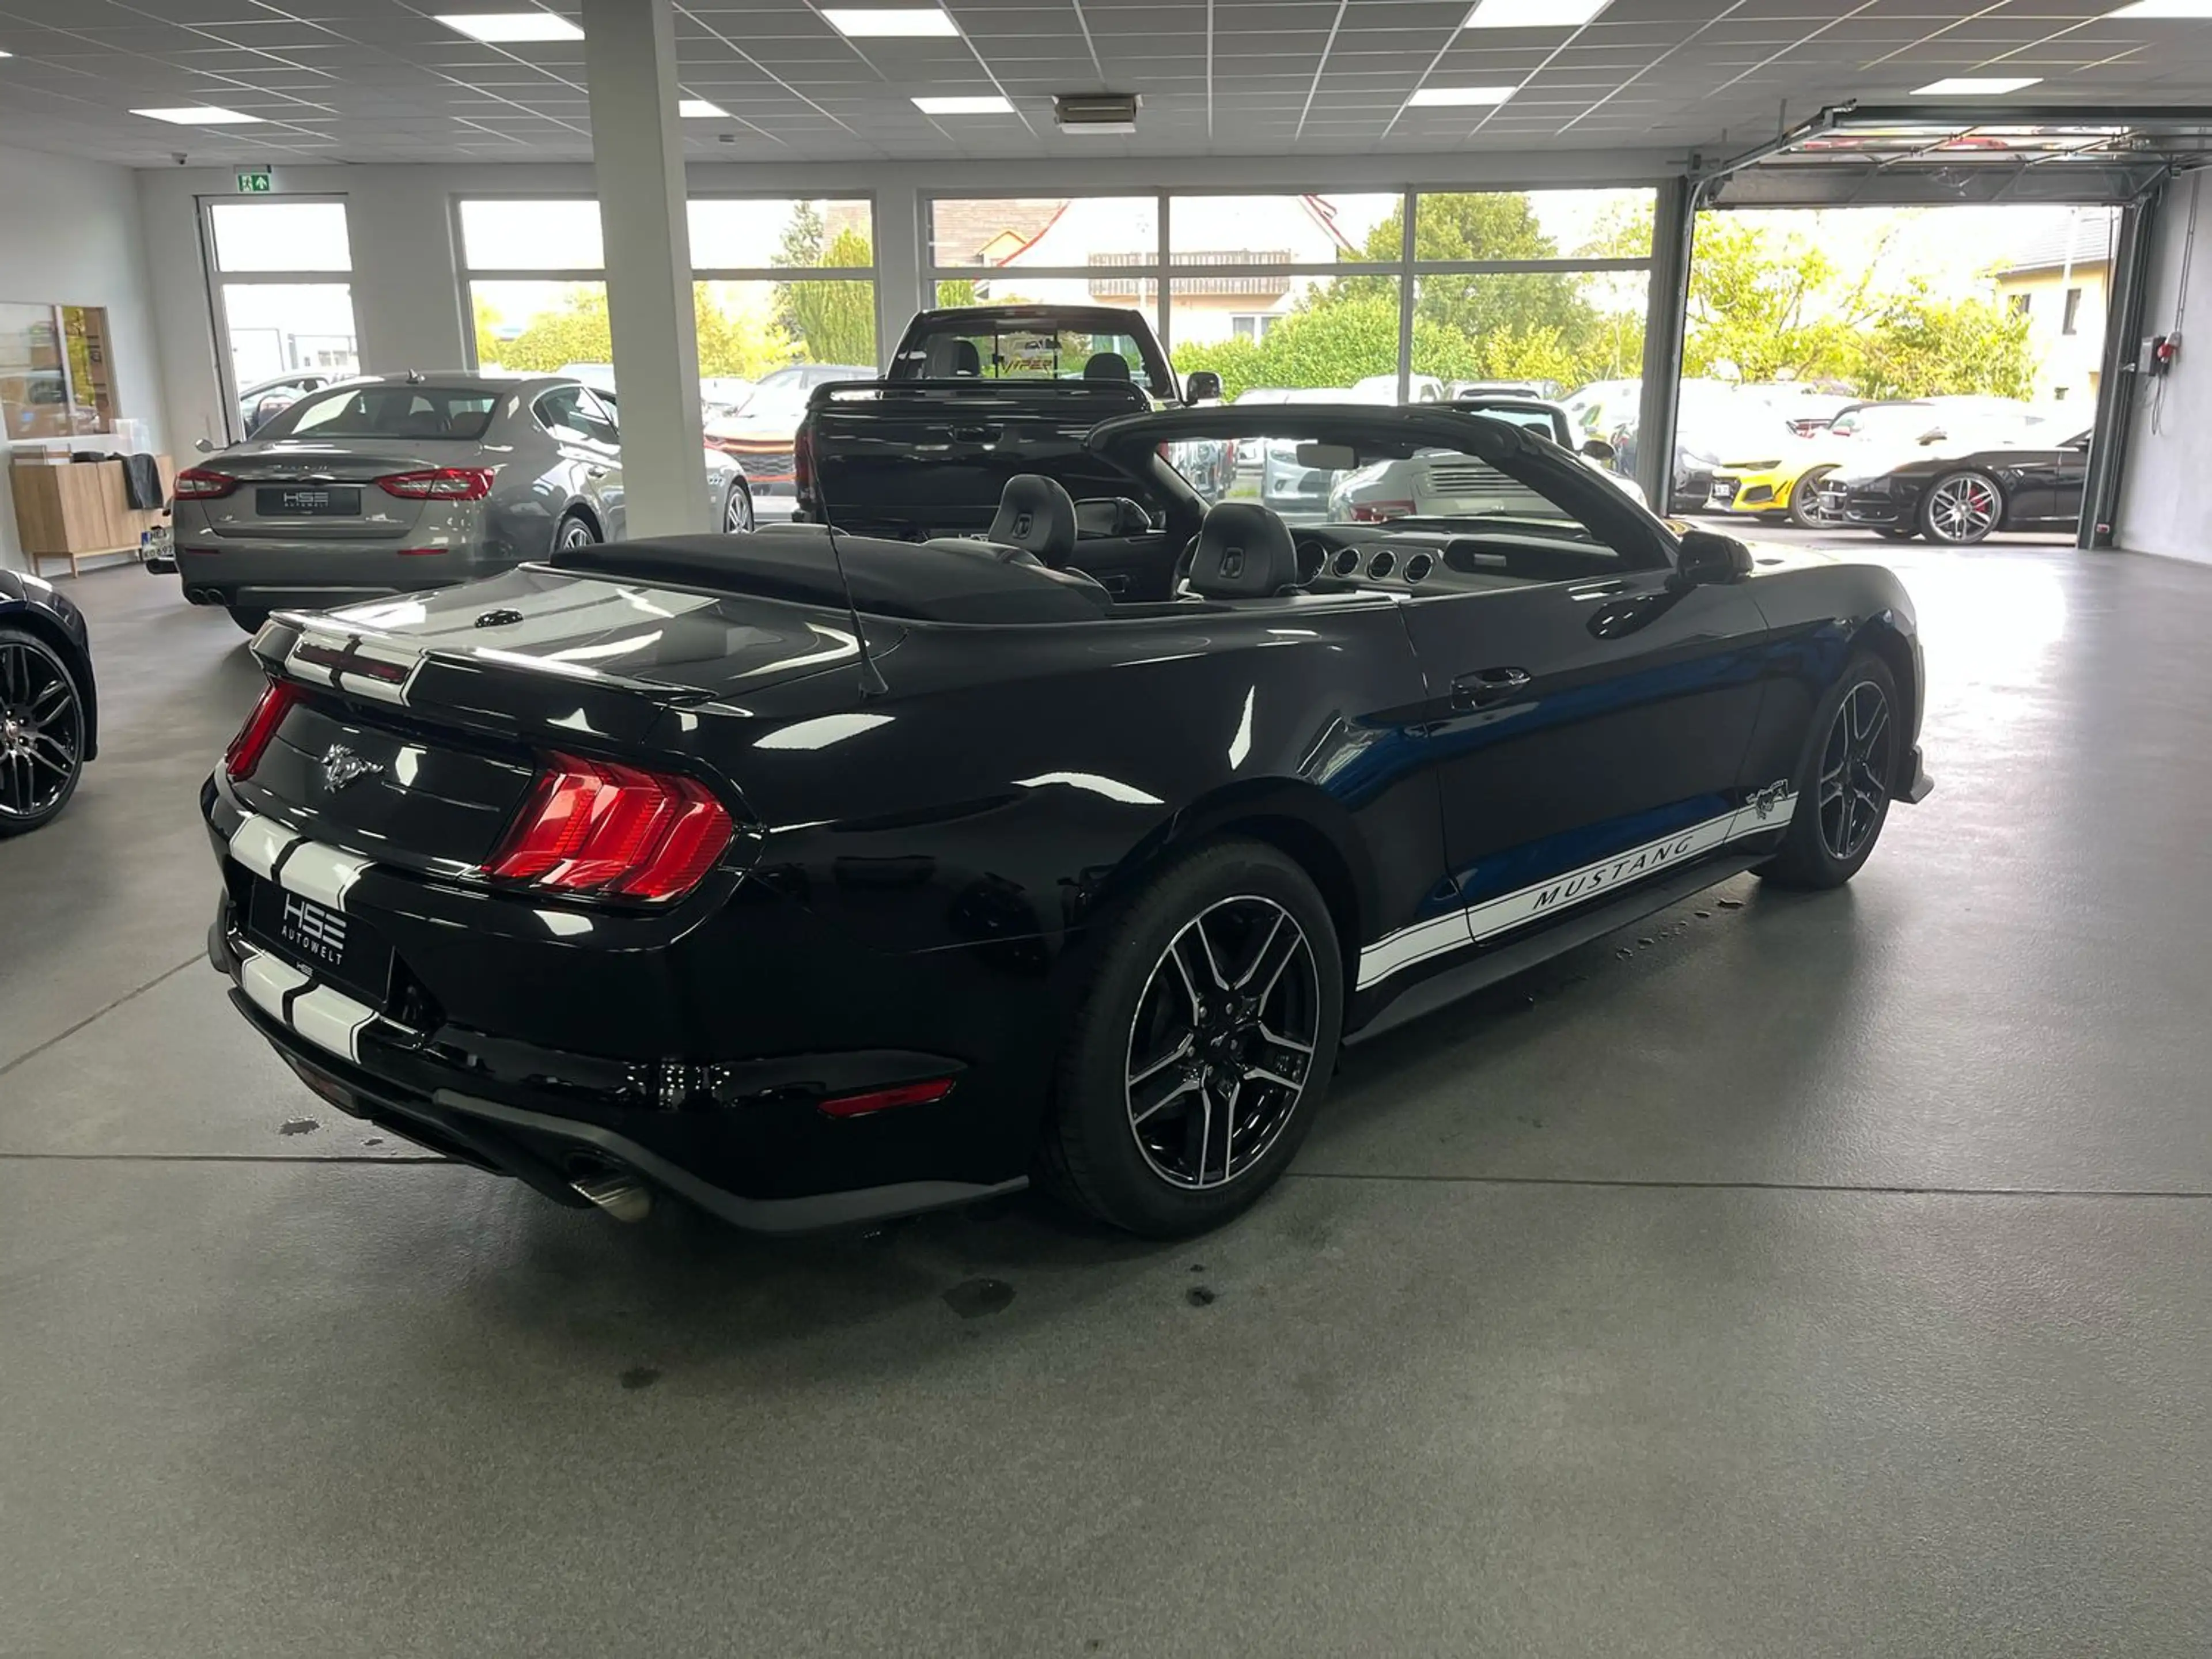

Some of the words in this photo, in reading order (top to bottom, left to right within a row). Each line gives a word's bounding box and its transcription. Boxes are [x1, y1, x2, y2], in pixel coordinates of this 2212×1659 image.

[1001, 359, 1052, 374] VIPER
[283, 491, 329, 502] HSE
[1532, 835, 1694, 910] MUSTANG
[283, 893, 347, 950] HSE
[281, 925, 342, 965] AUTOWELT
